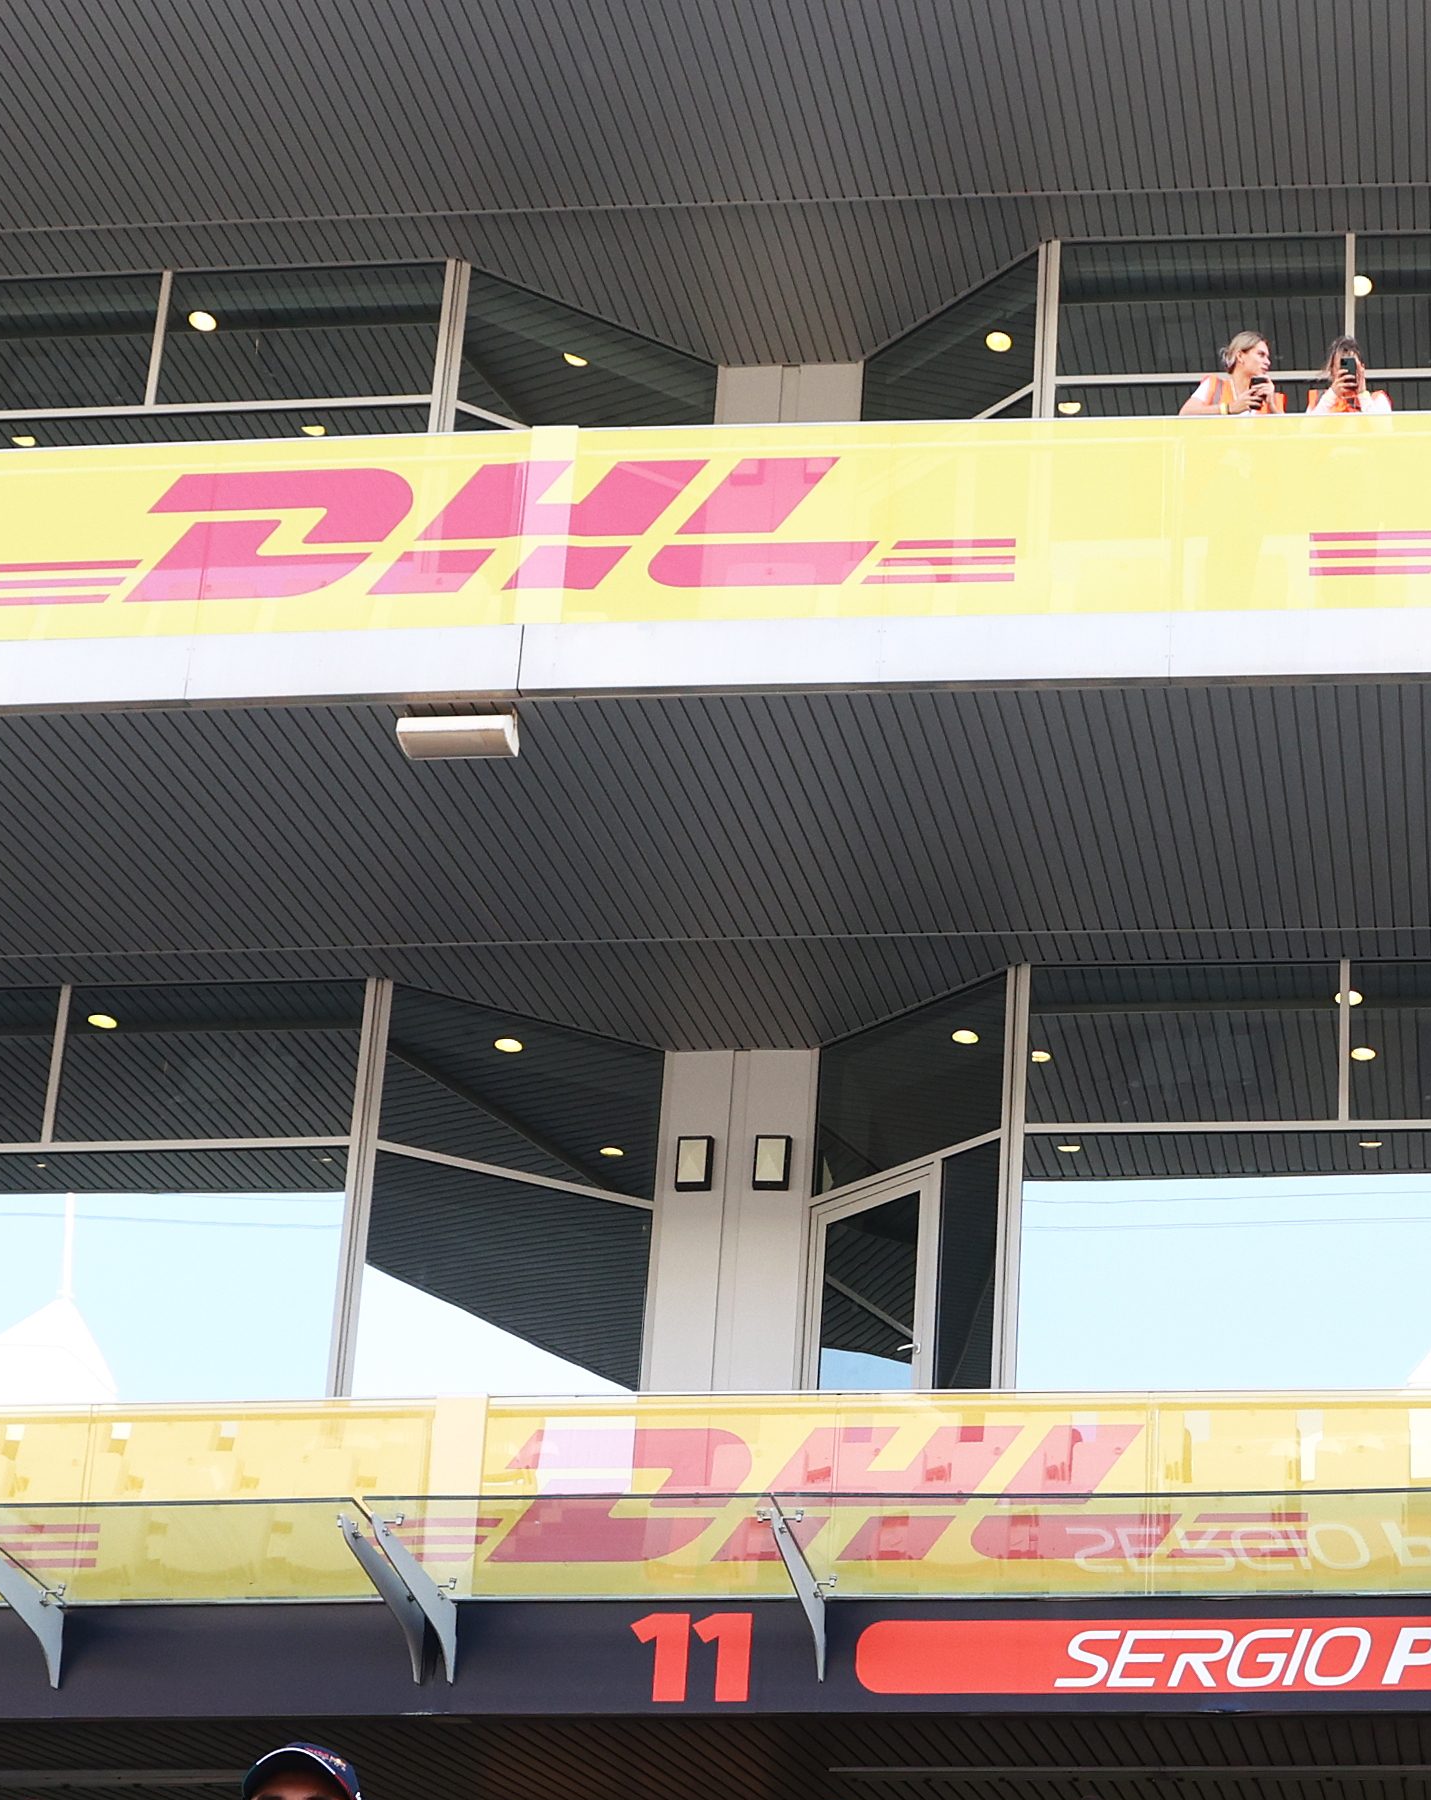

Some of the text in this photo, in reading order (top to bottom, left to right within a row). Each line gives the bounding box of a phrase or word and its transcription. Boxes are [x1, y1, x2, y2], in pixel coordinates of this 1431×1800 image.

[122, 456, 877, 603] DHL
[485, 1424, 1176, 1562] DHL
[630, 1612, 752, 1702] 11
[1054, 1628, 1371, 1688] SERGIO
